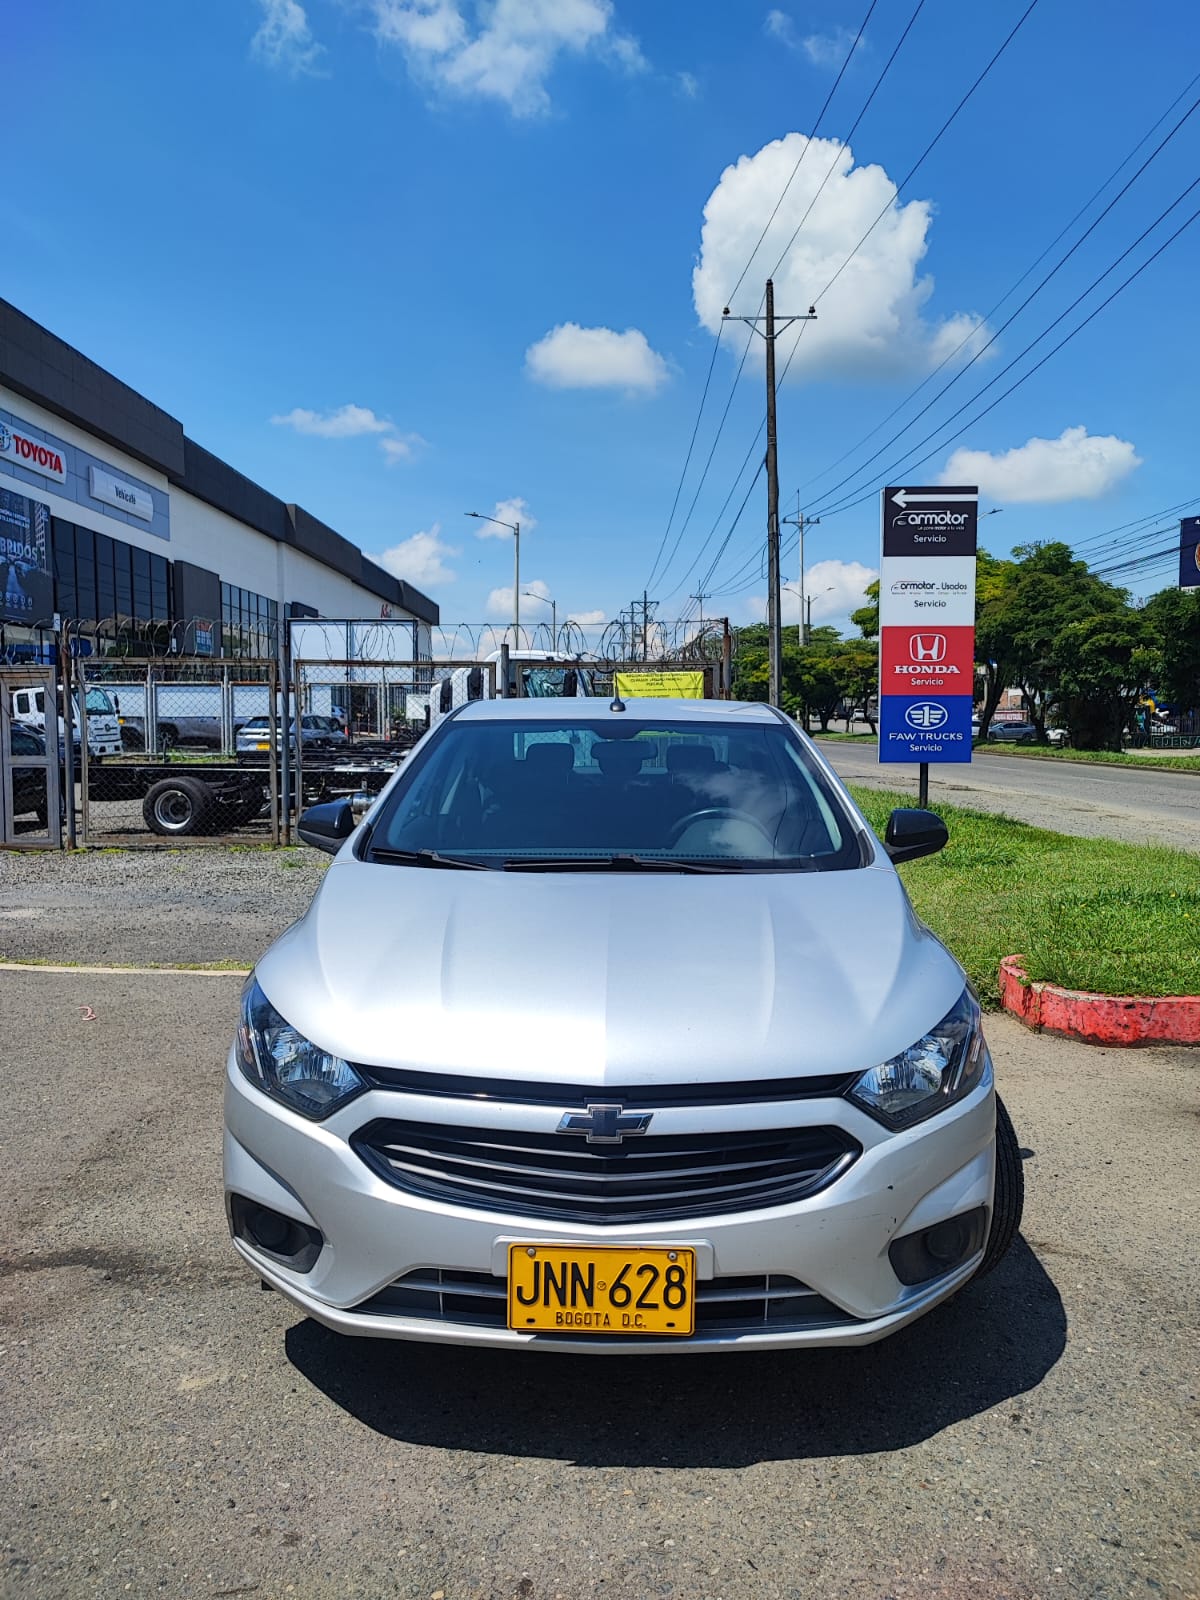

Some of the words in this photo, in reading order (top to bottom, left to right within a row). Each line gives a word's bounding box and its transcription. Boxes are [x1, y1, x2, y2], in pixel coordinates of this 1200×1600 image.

[12, 433, 63, 474] TOYOTA
[913, 534, 947, 543] Servicio
[941, 582, 967, 590] Usados
[914, 600, 947, 608] Servicio
[895, 665, 960, 674] HONDA
[911, 677, 944, 686] Servicio
[889, 732, 916, 741] FAW
[918, 732, 963, 741] TRUCKS
[909, 743, 942, 752] Servicio
[516, 1260, 595, 1307] JNN
[608, 1263, 687, 1310] 628
[555, 1311, 611, 1327] BOGOTA
[622, 1313, 647, 1329] D.C.
